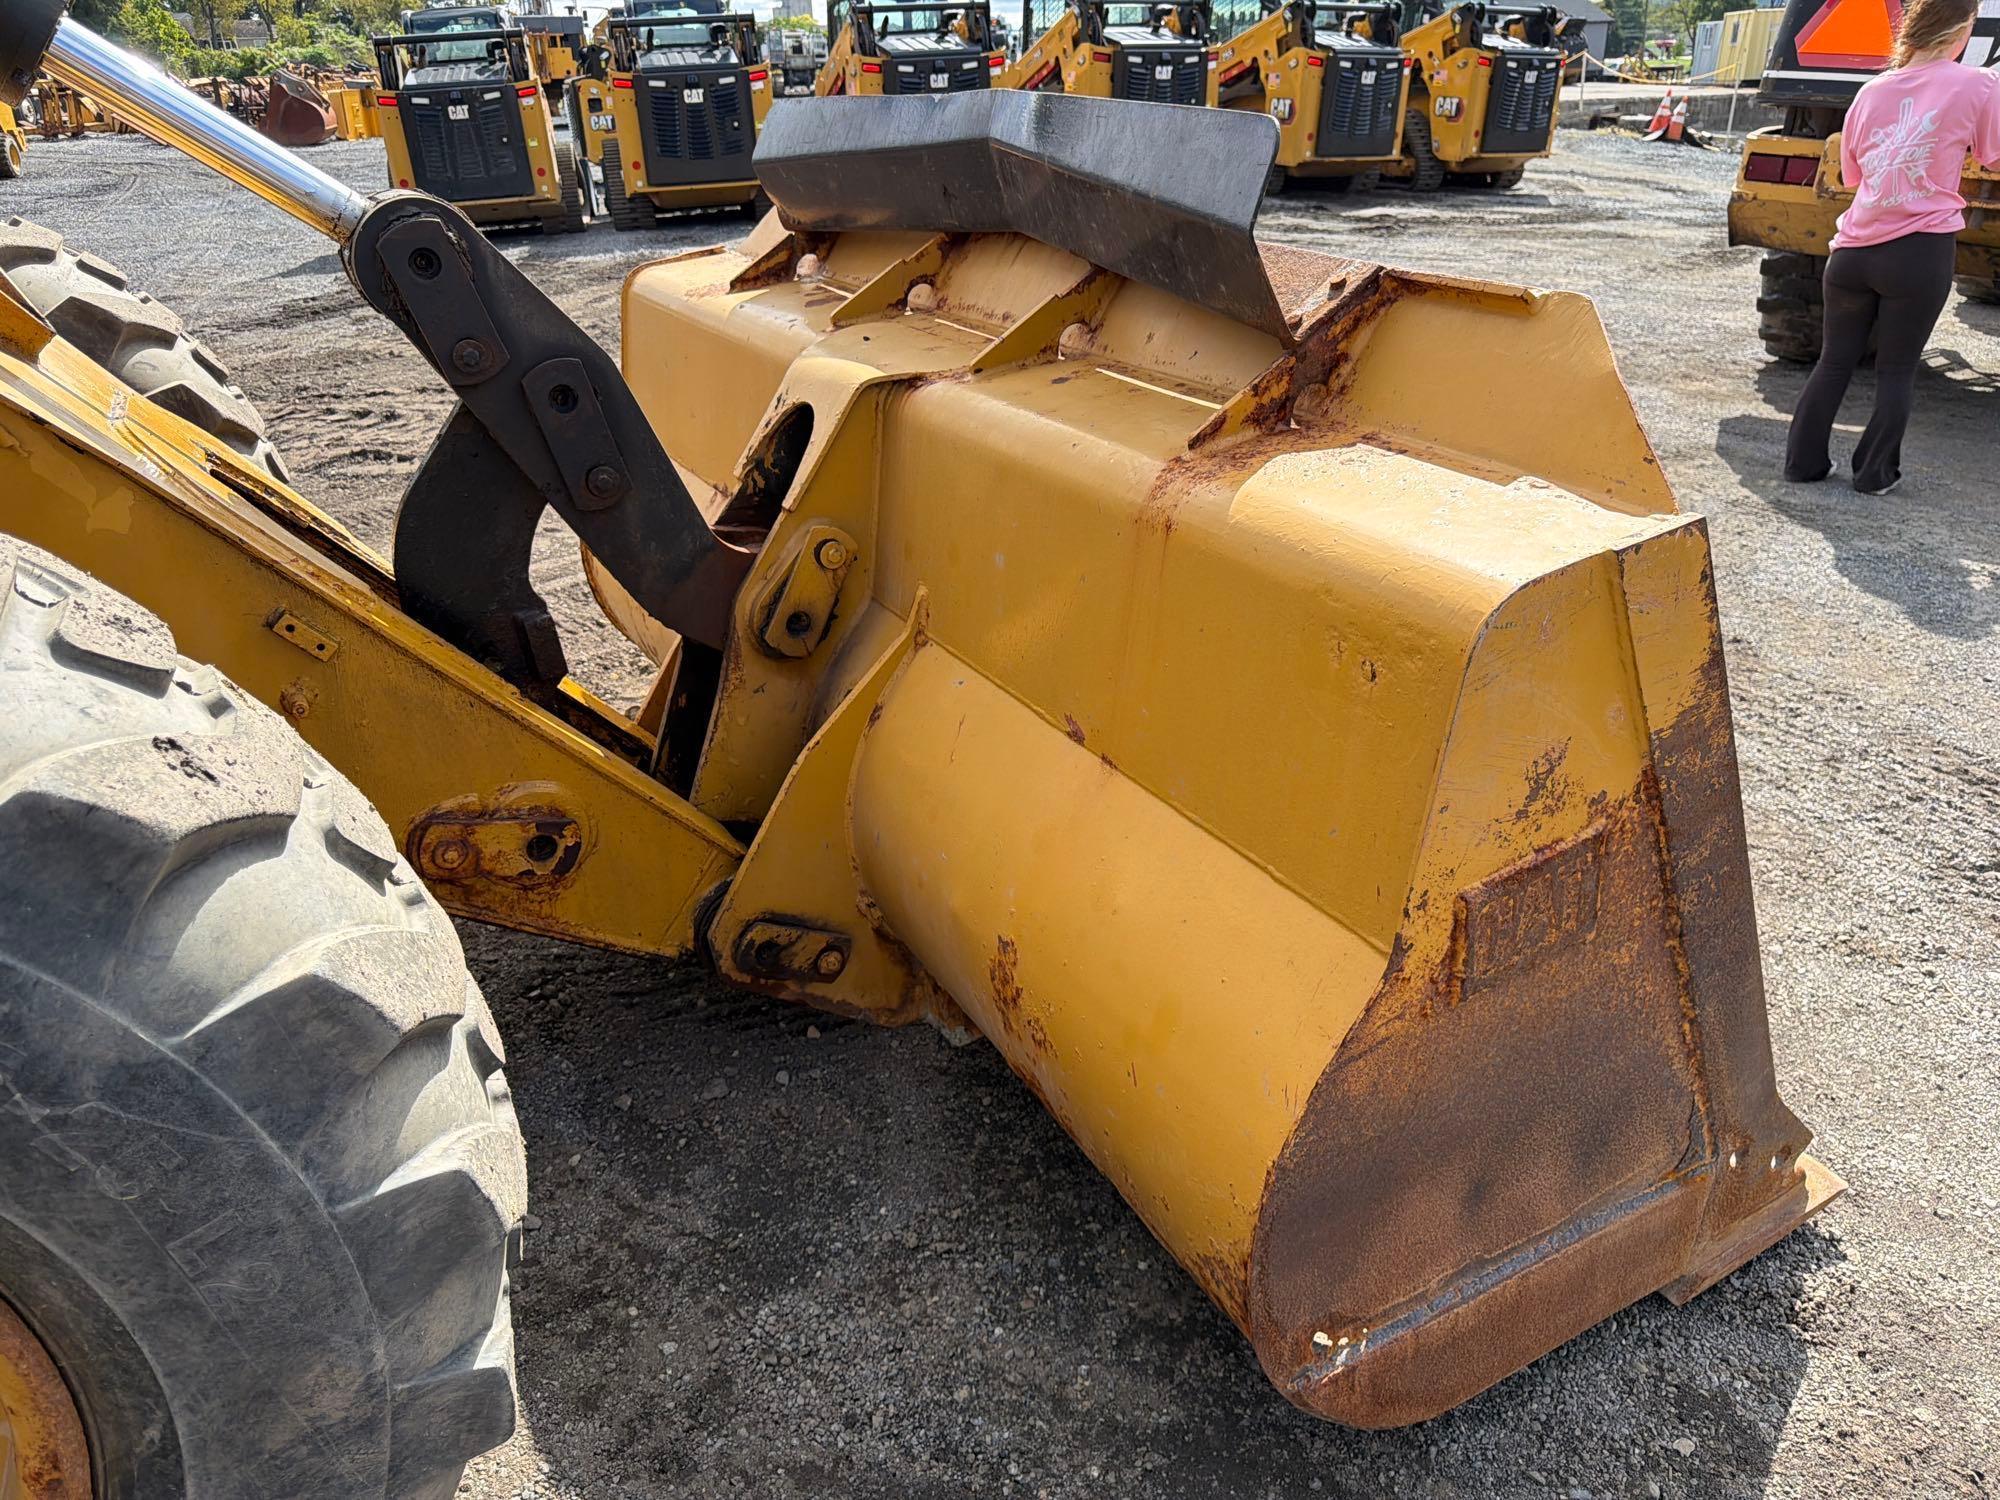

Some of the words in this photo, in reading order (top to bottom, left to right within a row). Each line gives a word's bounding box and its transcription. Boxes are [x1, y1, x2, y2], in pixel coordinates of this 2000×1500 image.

[930, 73, 949, 88] CAT
[1155, 65, 1173, 80] CAT
[1524, 70, 1538, 84] CAT
[683, 88, 704, 103] CAT
[448, 104, 470, 120] CAT
[1270, 98, 1292, 119] CAT
[1435, 96, 1459, 117] CAT
[590, 115, 613, 131] CAT
[1893, 143, 1936, 165] ZONE
